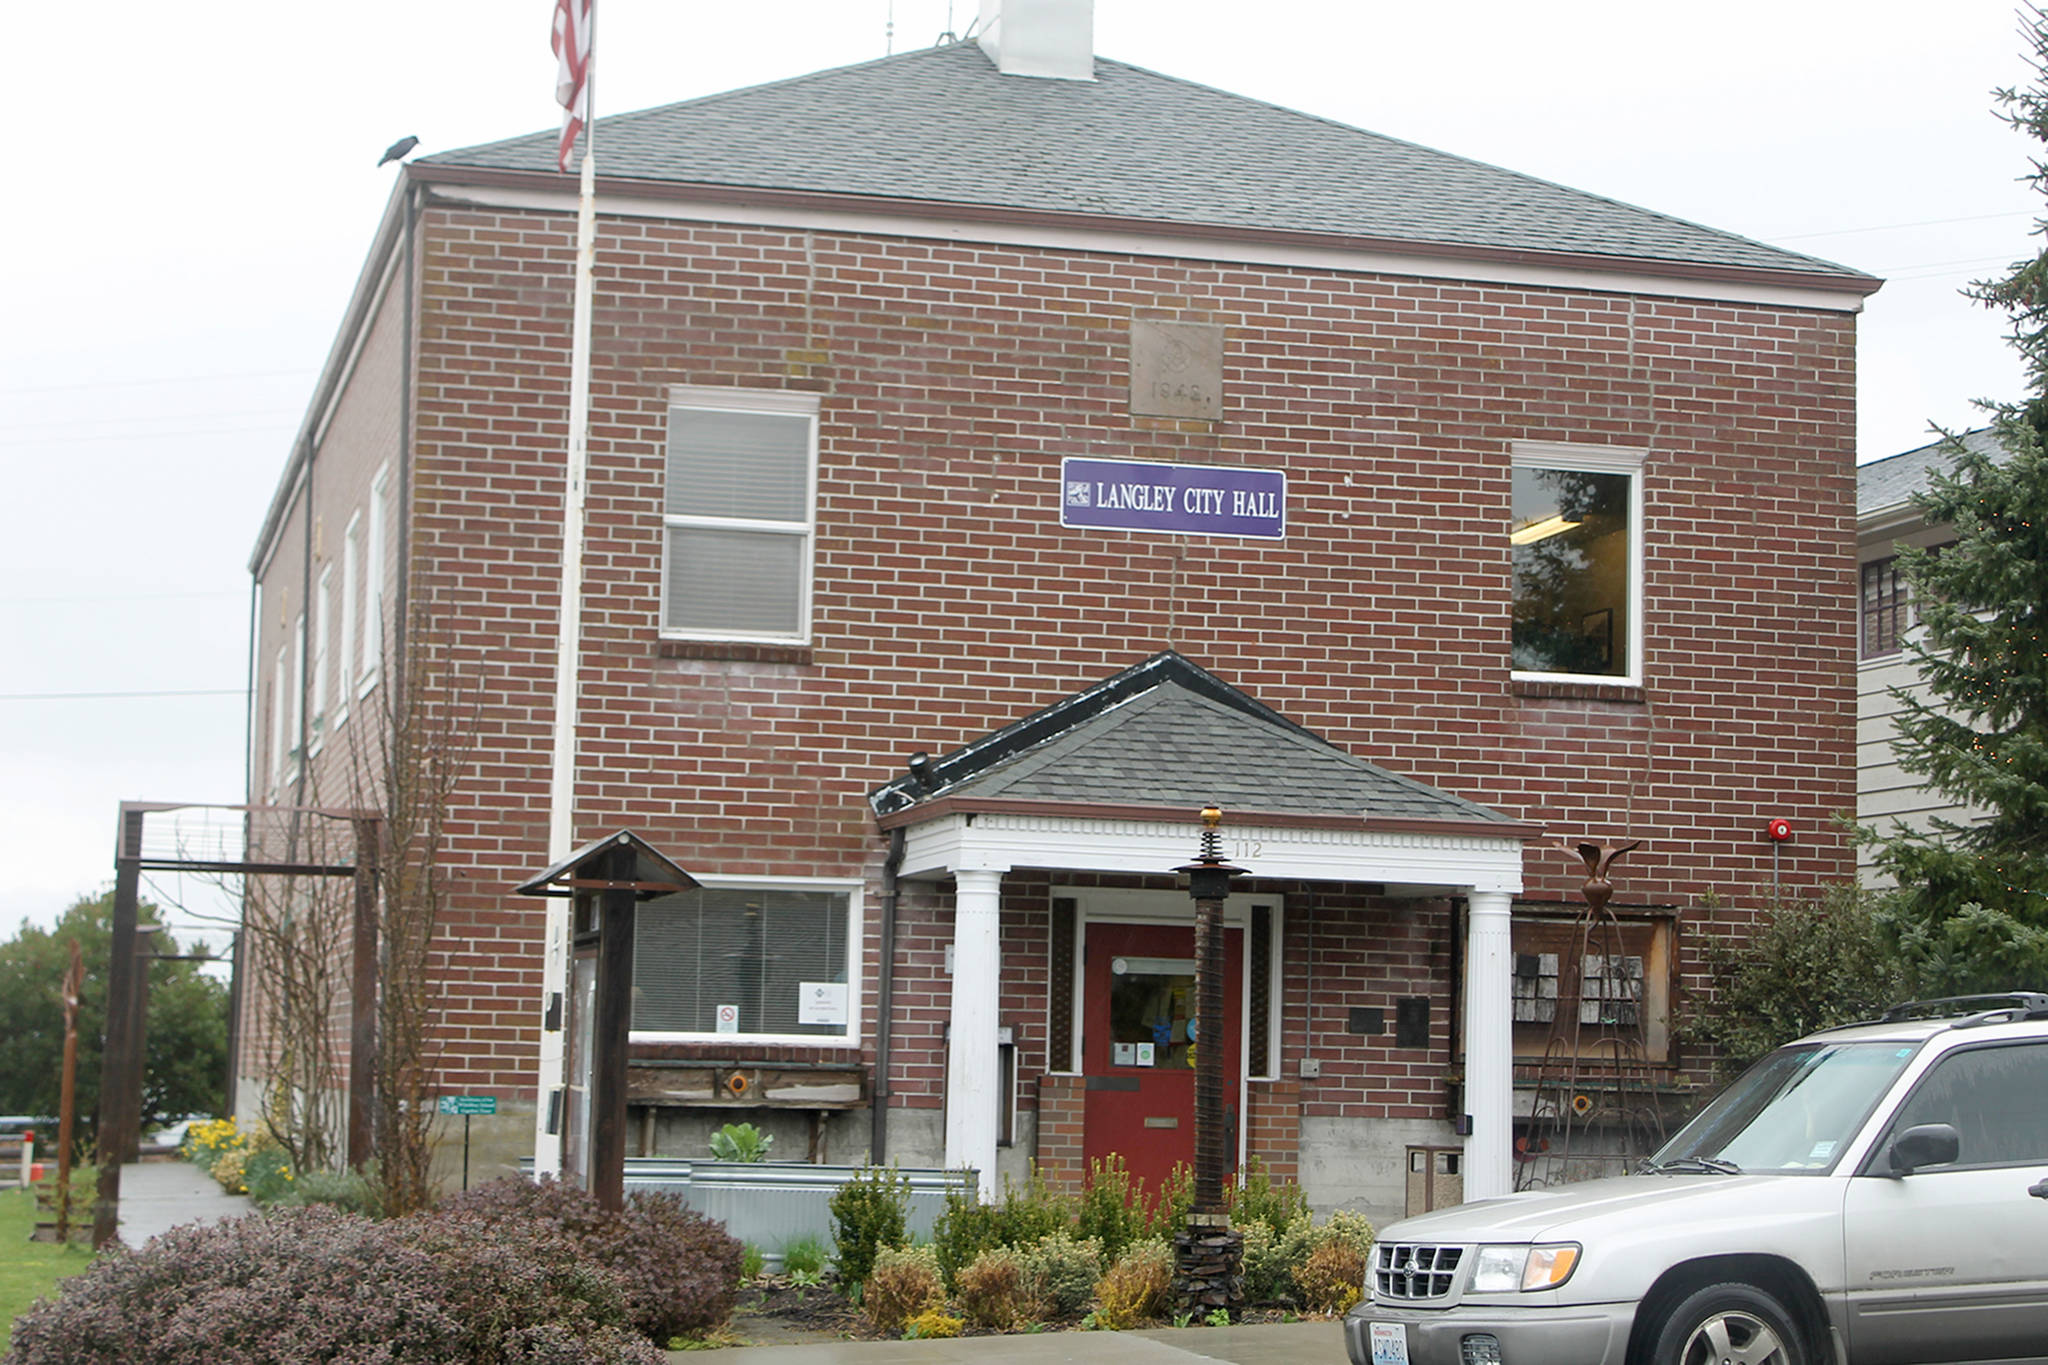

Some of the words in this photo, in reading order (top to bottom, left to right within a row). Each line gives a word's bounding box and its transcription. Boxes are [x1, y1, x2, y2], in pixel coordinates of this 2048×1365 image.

[1096, 482, 1177, 512] LANGLEY
[1183, 487, 1226, 516] CITY
[1232, 490, 1280, 519] HALL
[1234, 842, 1263, 858] 112
